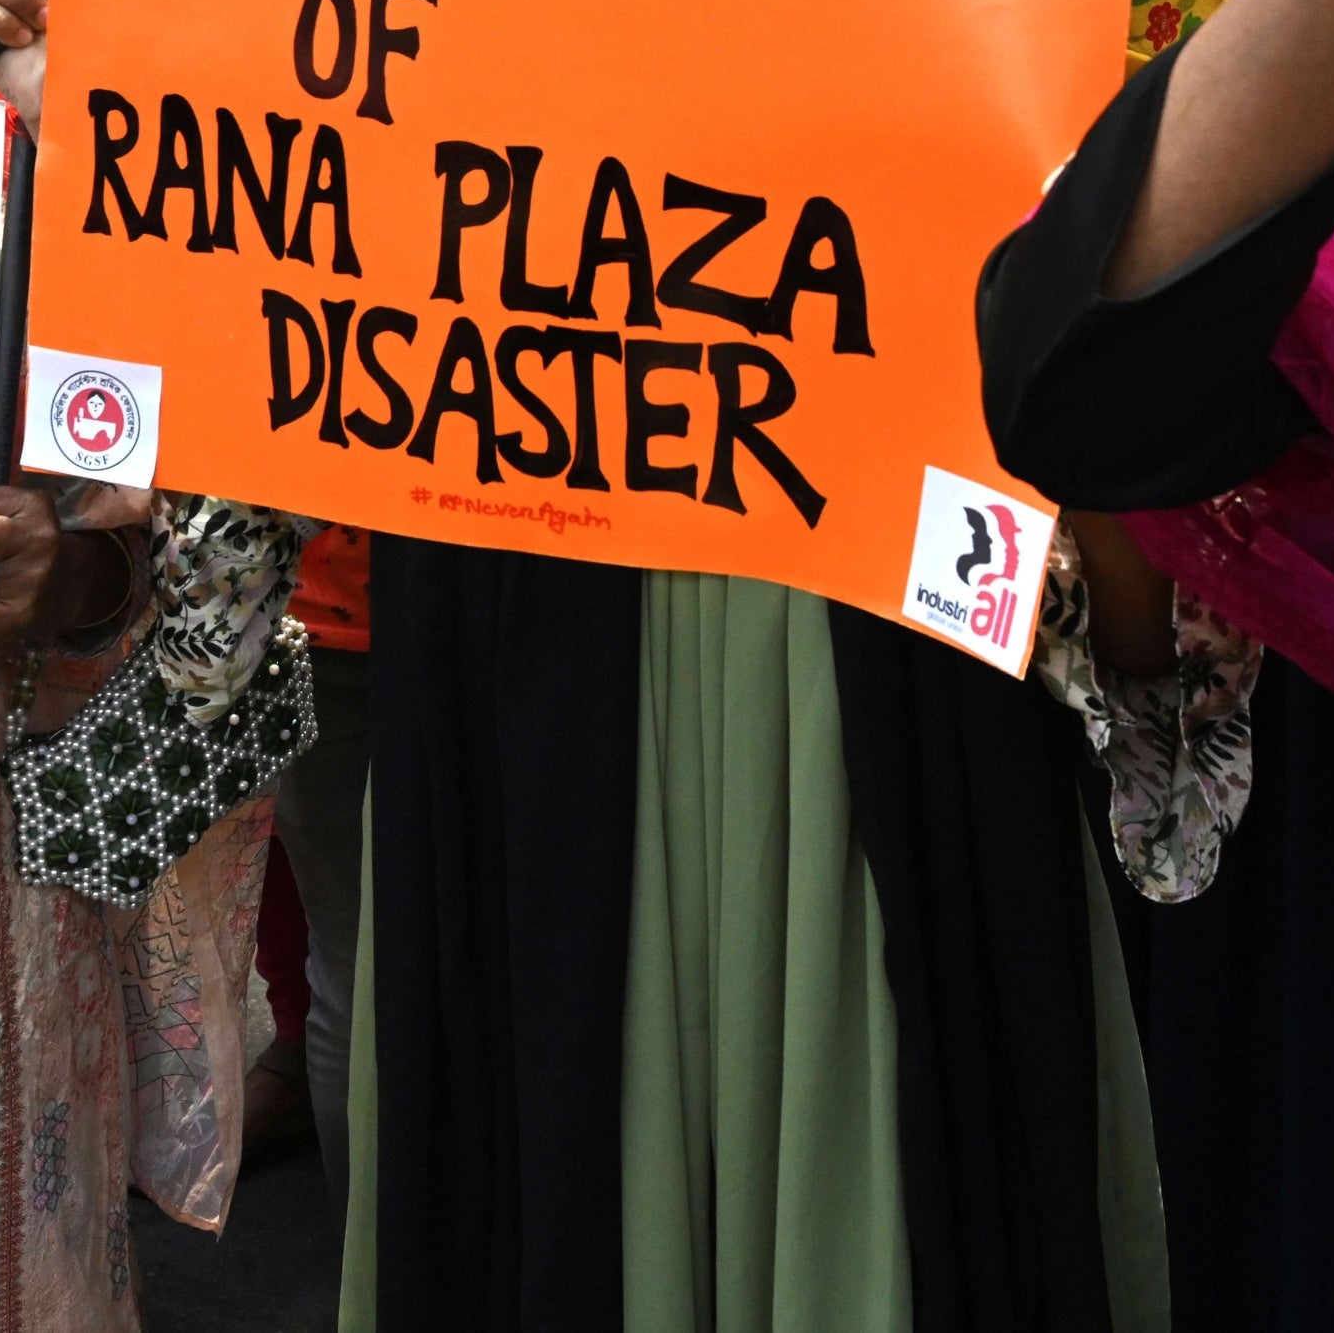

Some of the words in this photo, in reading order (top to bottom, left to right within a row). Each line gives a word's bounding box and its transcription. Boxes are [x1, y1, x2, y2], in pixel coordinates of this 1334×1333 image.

[83, 89, 362, 277] RANA
[430, 140, 876, 357] PLAZA
[75, 451, 110, 466] SGSF
[262, 289, 827, 531] DISASTER
